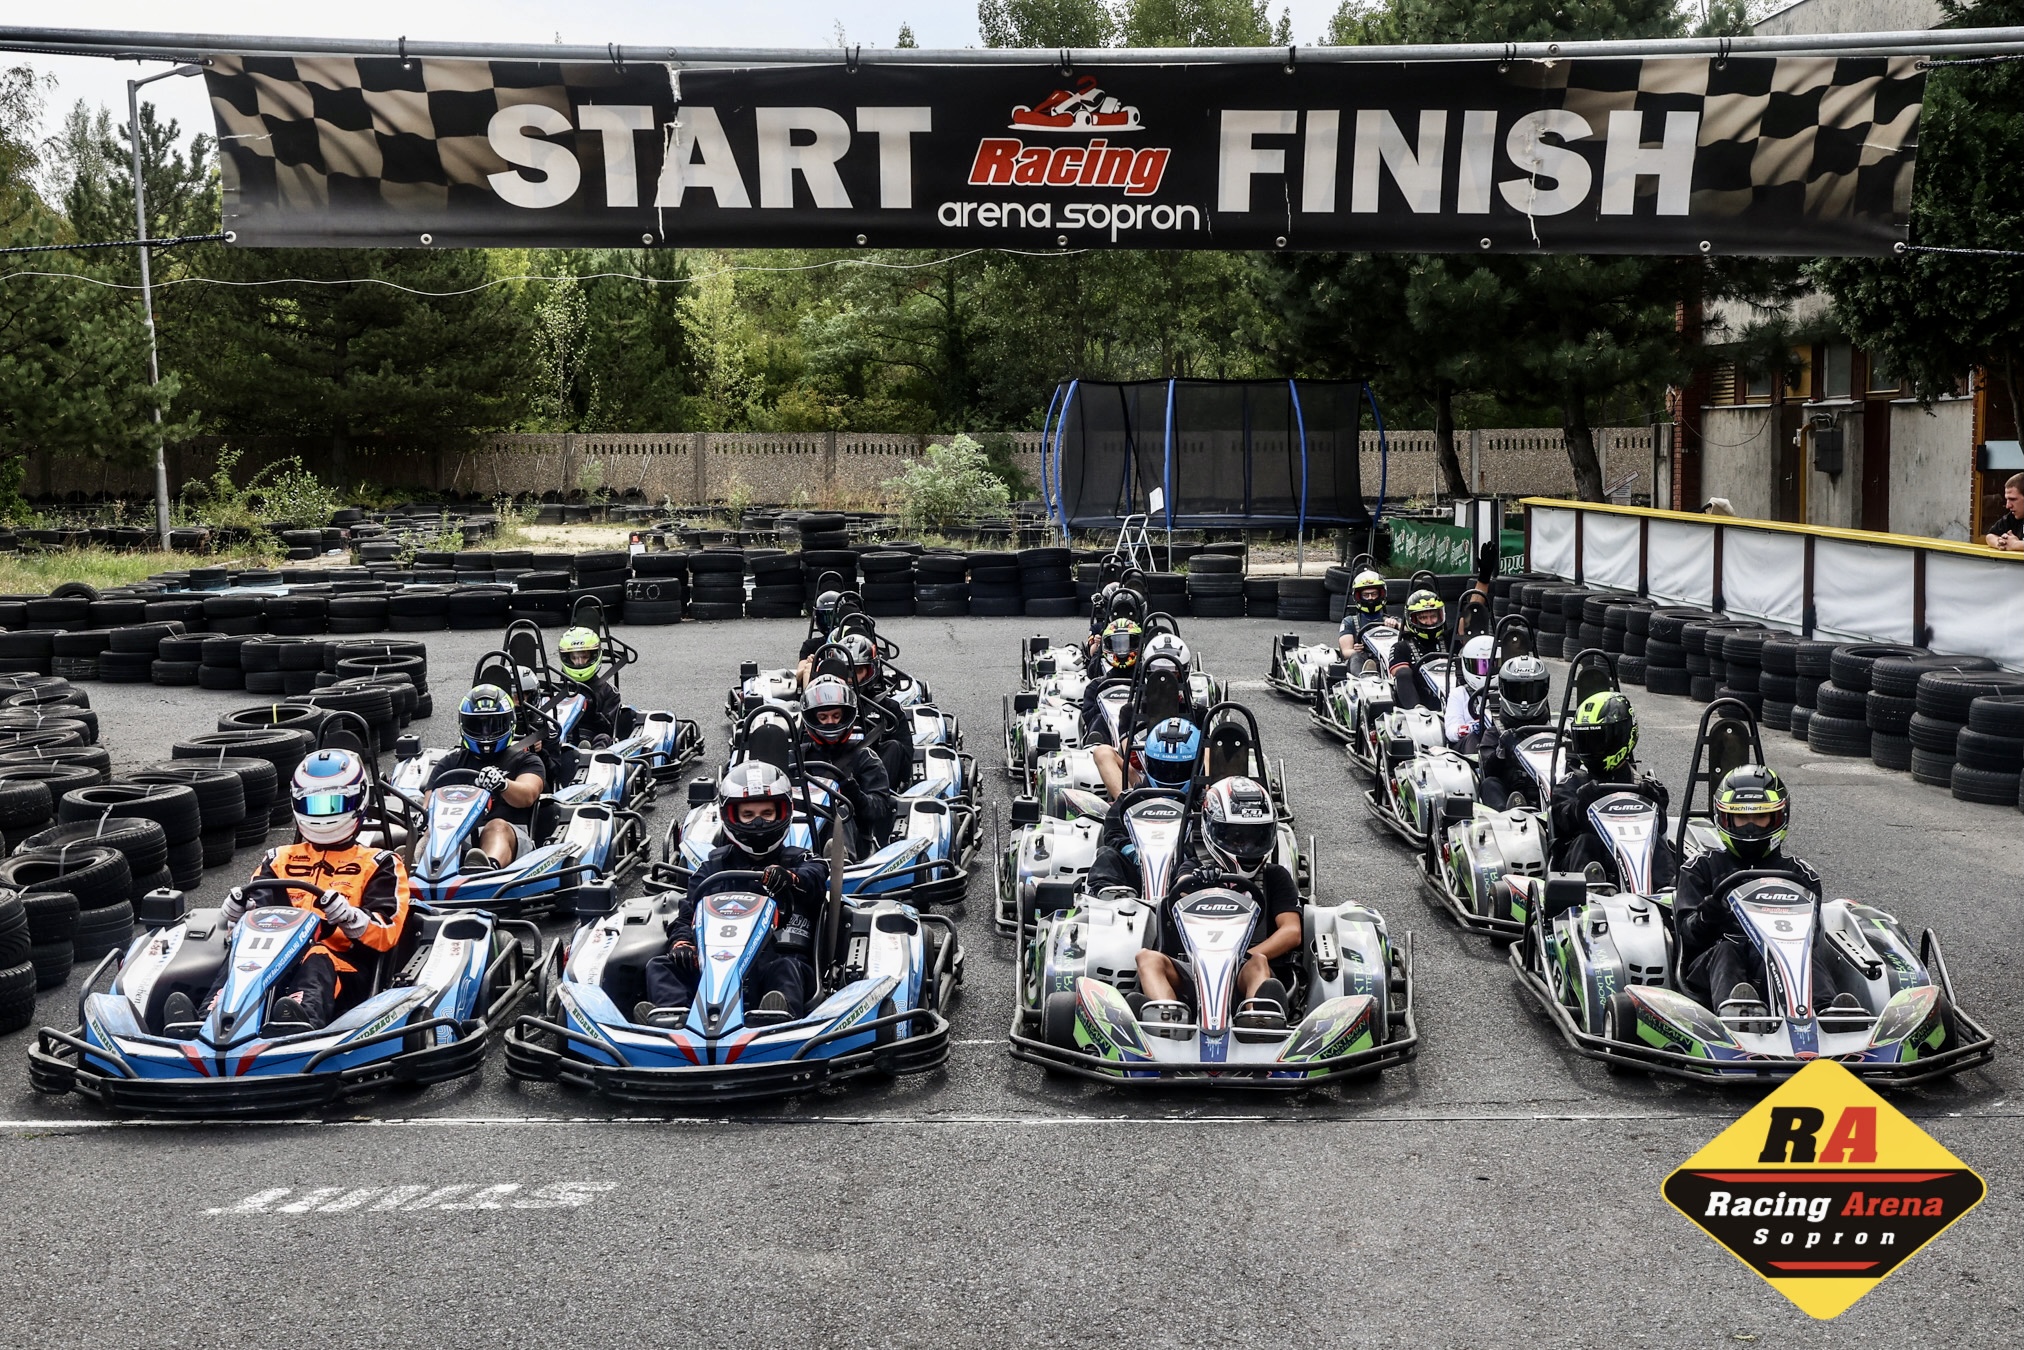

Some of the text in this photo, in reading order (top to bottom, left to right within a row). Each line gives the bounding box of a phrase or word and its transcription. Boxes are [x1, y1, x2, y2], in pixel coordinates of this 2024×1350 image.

[487, 103, 932, 210] START
[1218, 109, 1700, 216] FINISH
[968, 138, 1171, 196] Racing
[938, 203, 1200, 243] arena sopron
[441, 807, 464, 816] 12
[1151, 830, 1165, 840] 2
[1617, 826, 1642, 836] 11
[719, 925, 738, 938] 8
[1774, 920, 1794, 932] 8
[1207, 930, 1225, 943] 7
[248, 937, 274, 950] 11
